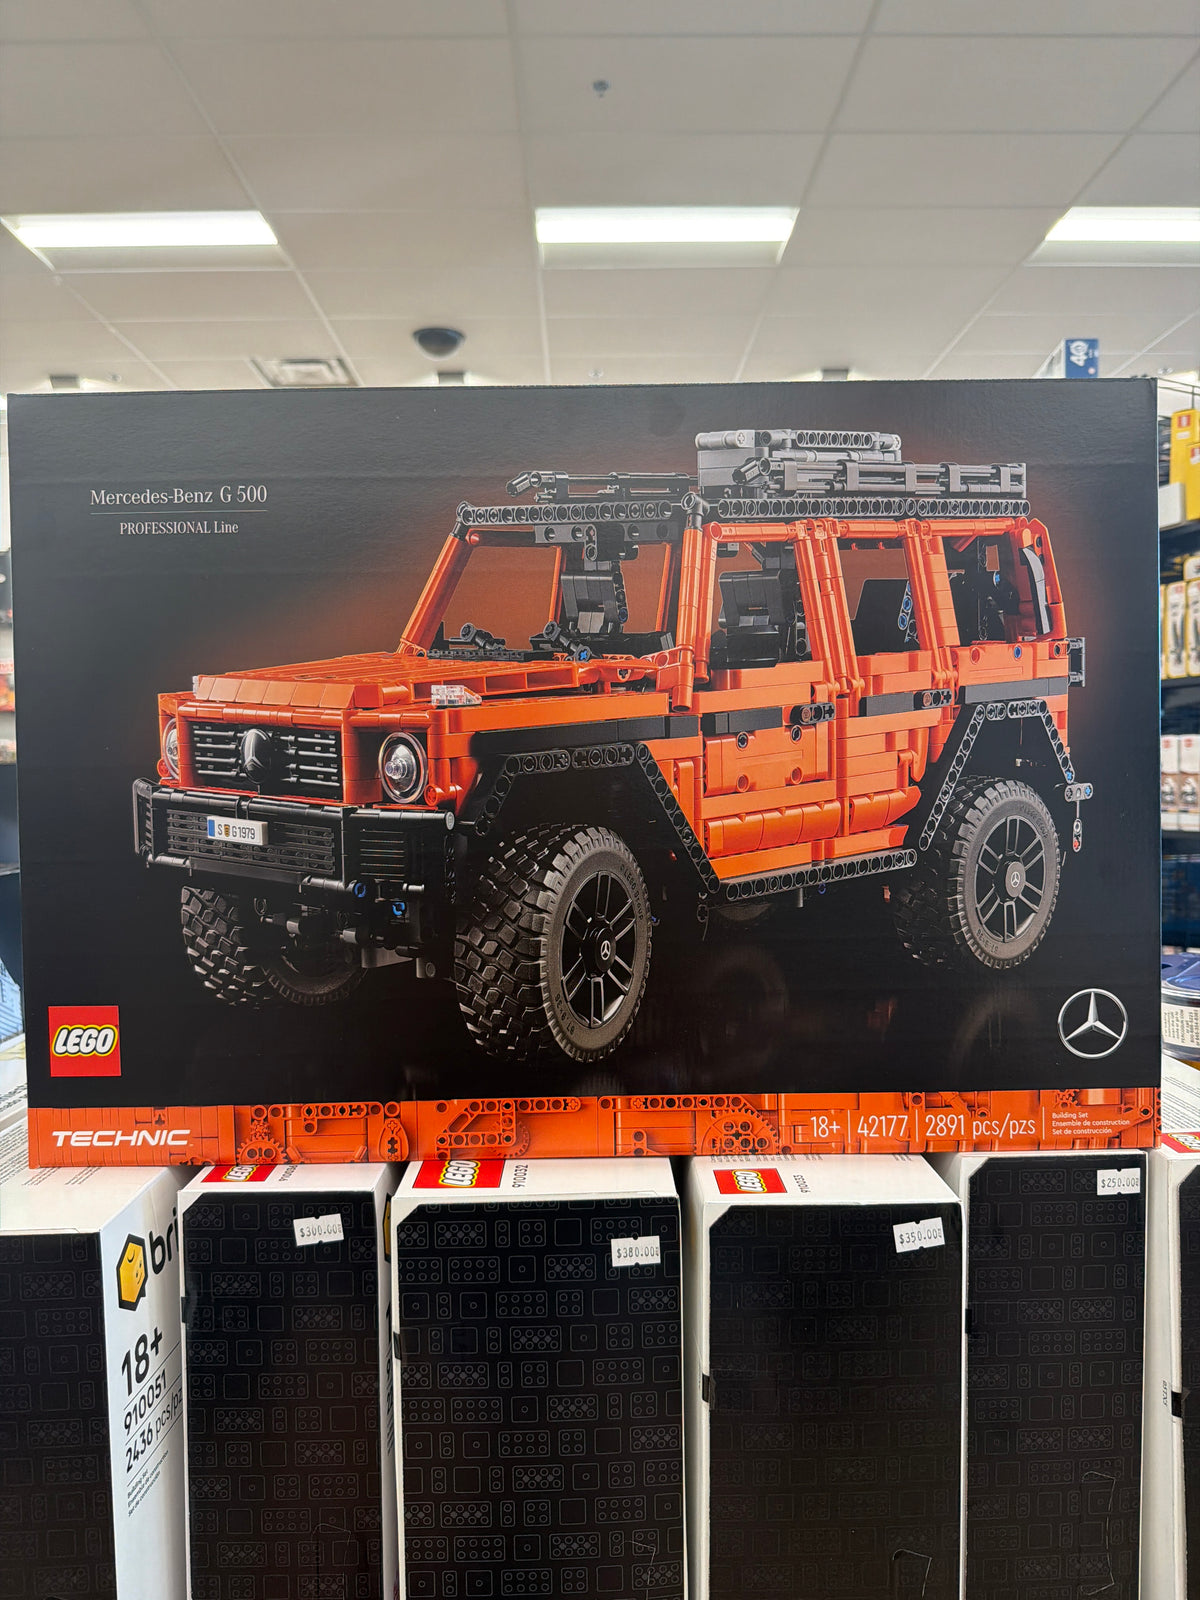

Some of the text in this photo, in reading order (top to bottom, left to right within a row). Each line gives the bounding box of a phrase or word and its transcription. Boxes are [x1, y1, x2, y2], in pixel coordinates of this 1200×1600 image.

[89, 485, 268, 505] Mercedes-Benz G 500
[120, 520, 239, 535] PROFESSIONAL Line
[53, 1025, 118, 1057] LEGO
[810, 1113, 1036, 1140] 18+ 42177 2891 pcs/pzs
[1052, 1112, 1077, 1120] Building
[52, 1129, 191, 1147] TECHNIC
[439, 1160, 480, 1187] LEGO
[512, 1164, 529, 1188] 910032
[731, 1169, 767, 1193] LEGO
[121, 1326, 163, 1397] 18+
[123, 1368, 167, 1437] 910051
[125, 1424, 153, 1474] 2436
